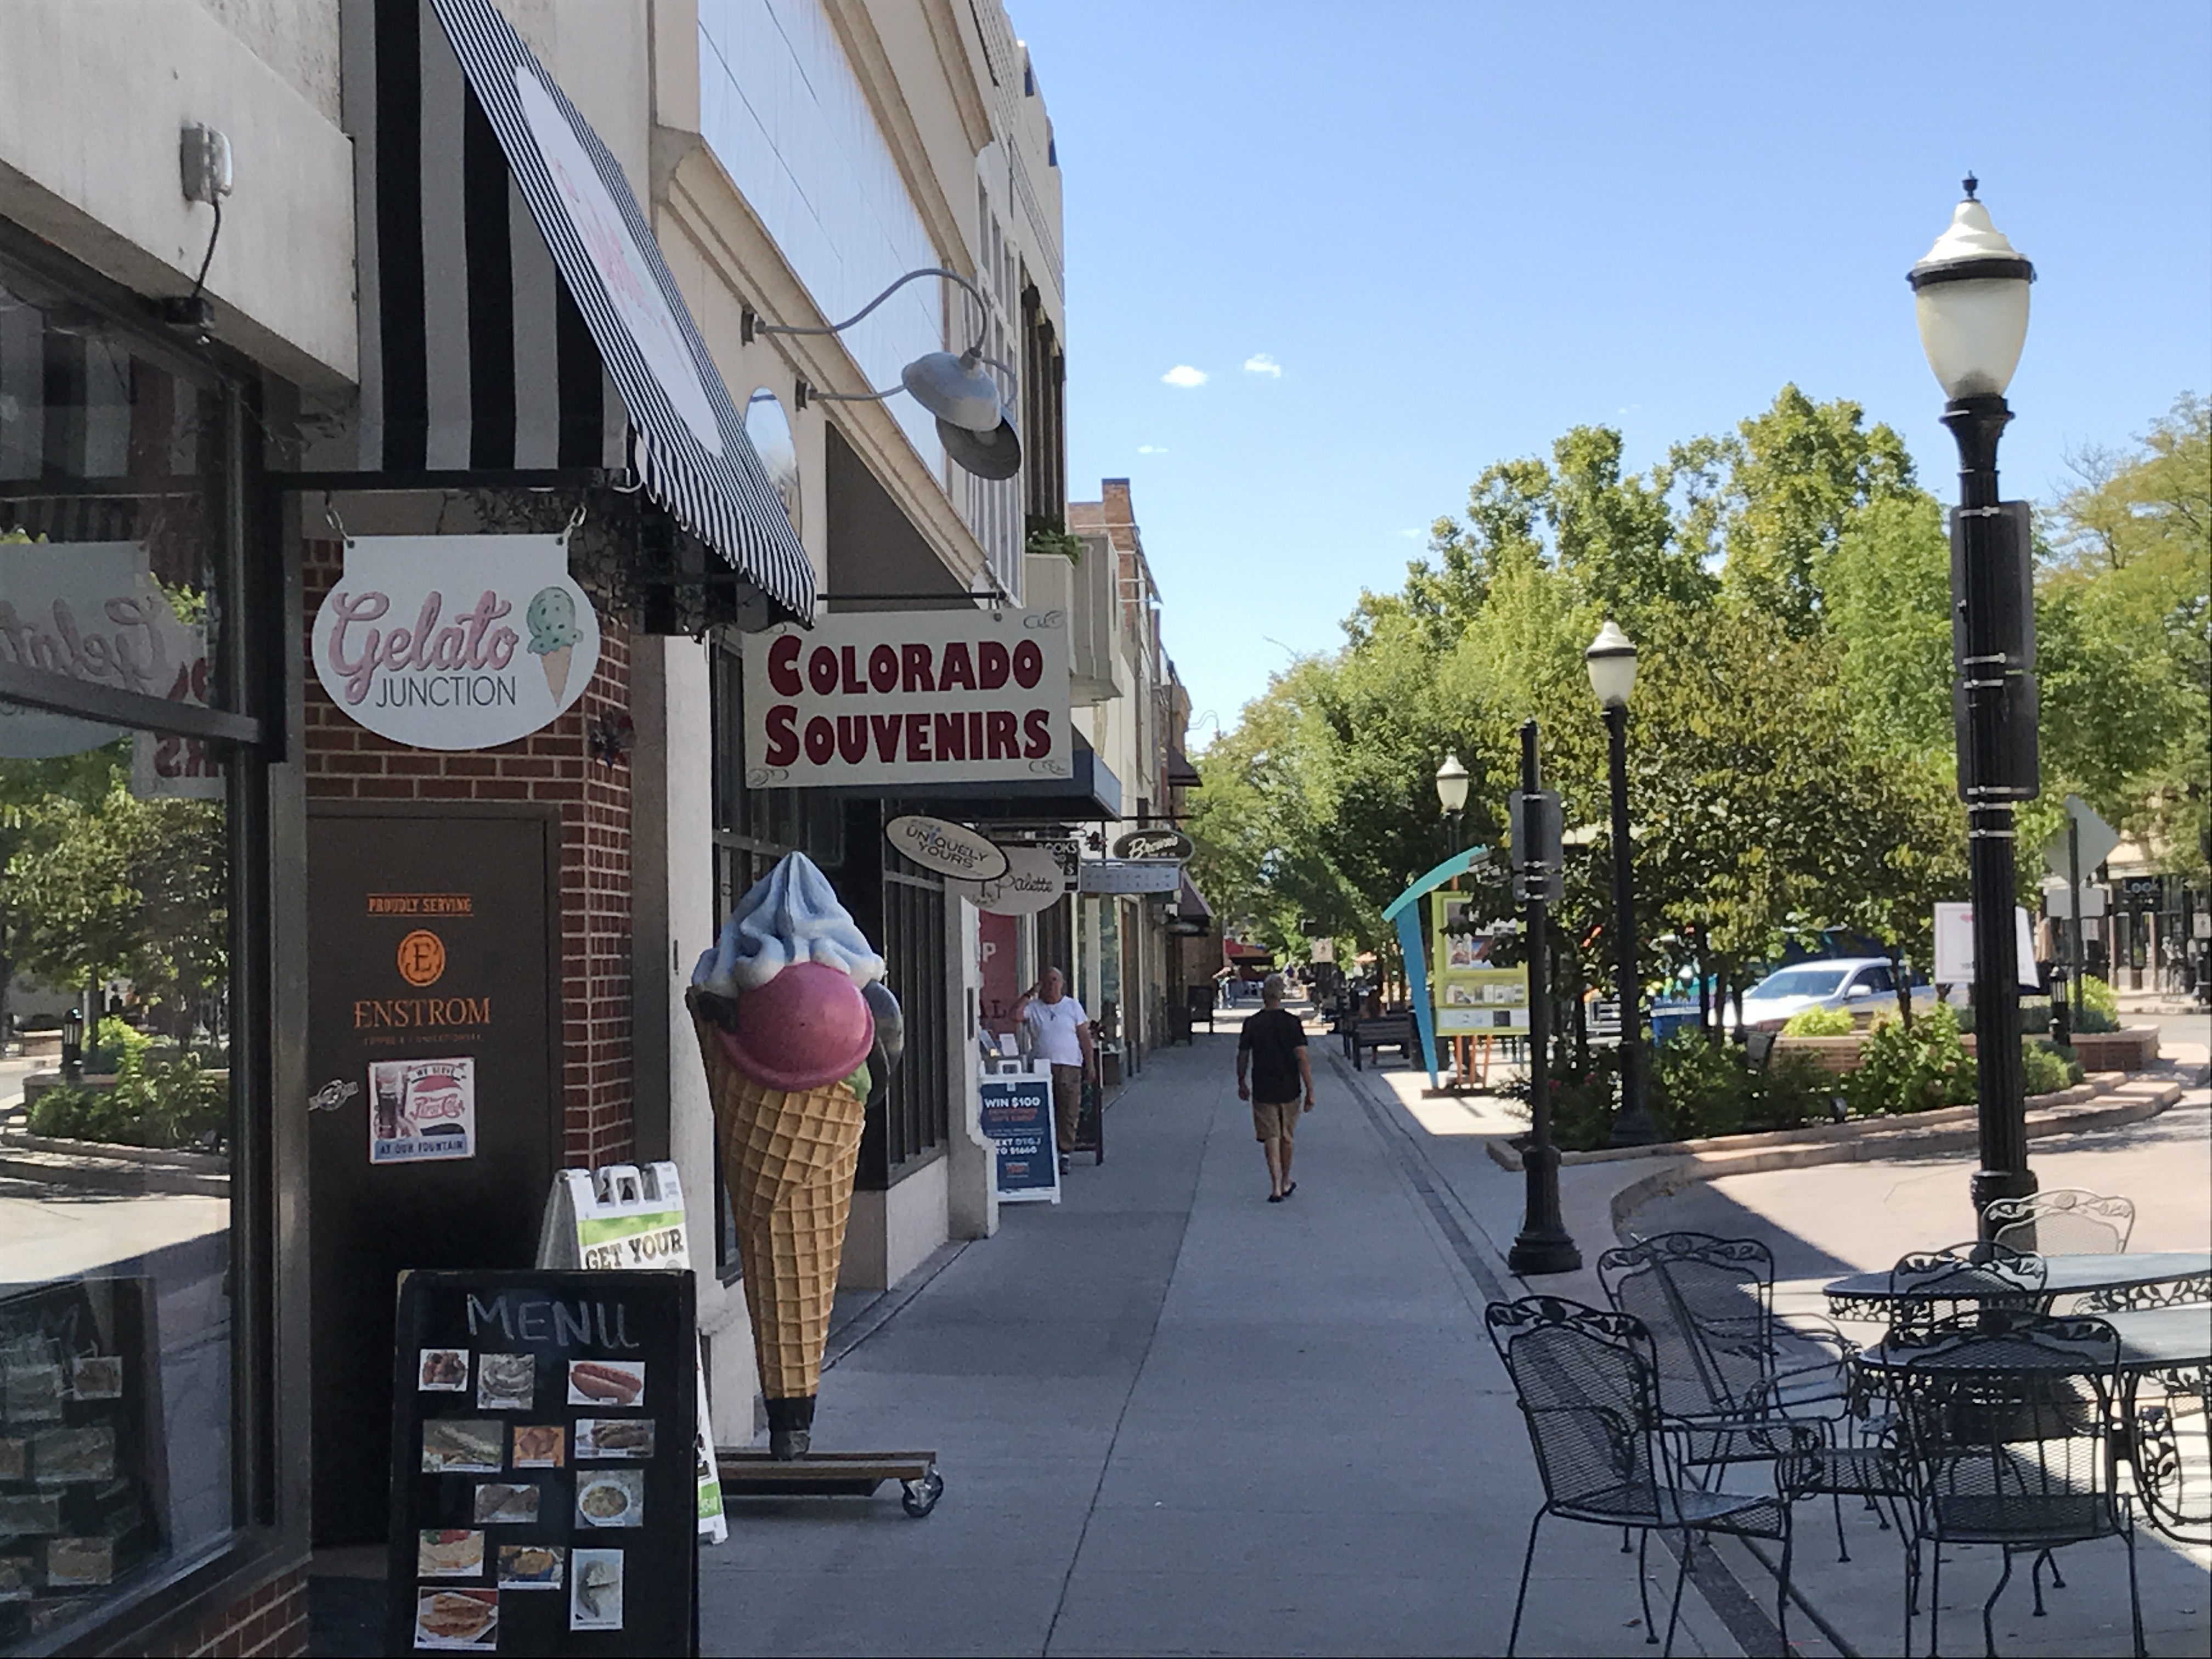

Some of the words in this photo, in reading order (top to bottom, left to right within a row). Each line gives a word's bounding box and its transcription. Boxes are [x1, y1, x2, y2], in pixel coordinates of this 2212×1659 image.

[328, 590, 520, 706] Gelato
[768, 635, 1042, 696] COLORADO
[376, 675, 516, 707] JUNCTION
[765, 705, 1051, 766] SOUVENIRS
[919, 842, 973, 868] YOURS
[369, 898, 419, 912] PROUDLY
[422, 898, 472, 912] SERVING
[354, 997, 490, 1029] ENSTROM
[984, 1098, 1009, 1108] WIN
[1012, 1097, 1041, 1108] $100
[585, 1243, 623, 1269] GET
[629, 1228, 684, 1263] YOUR
[467, 1294, 639, 1348] MENU
